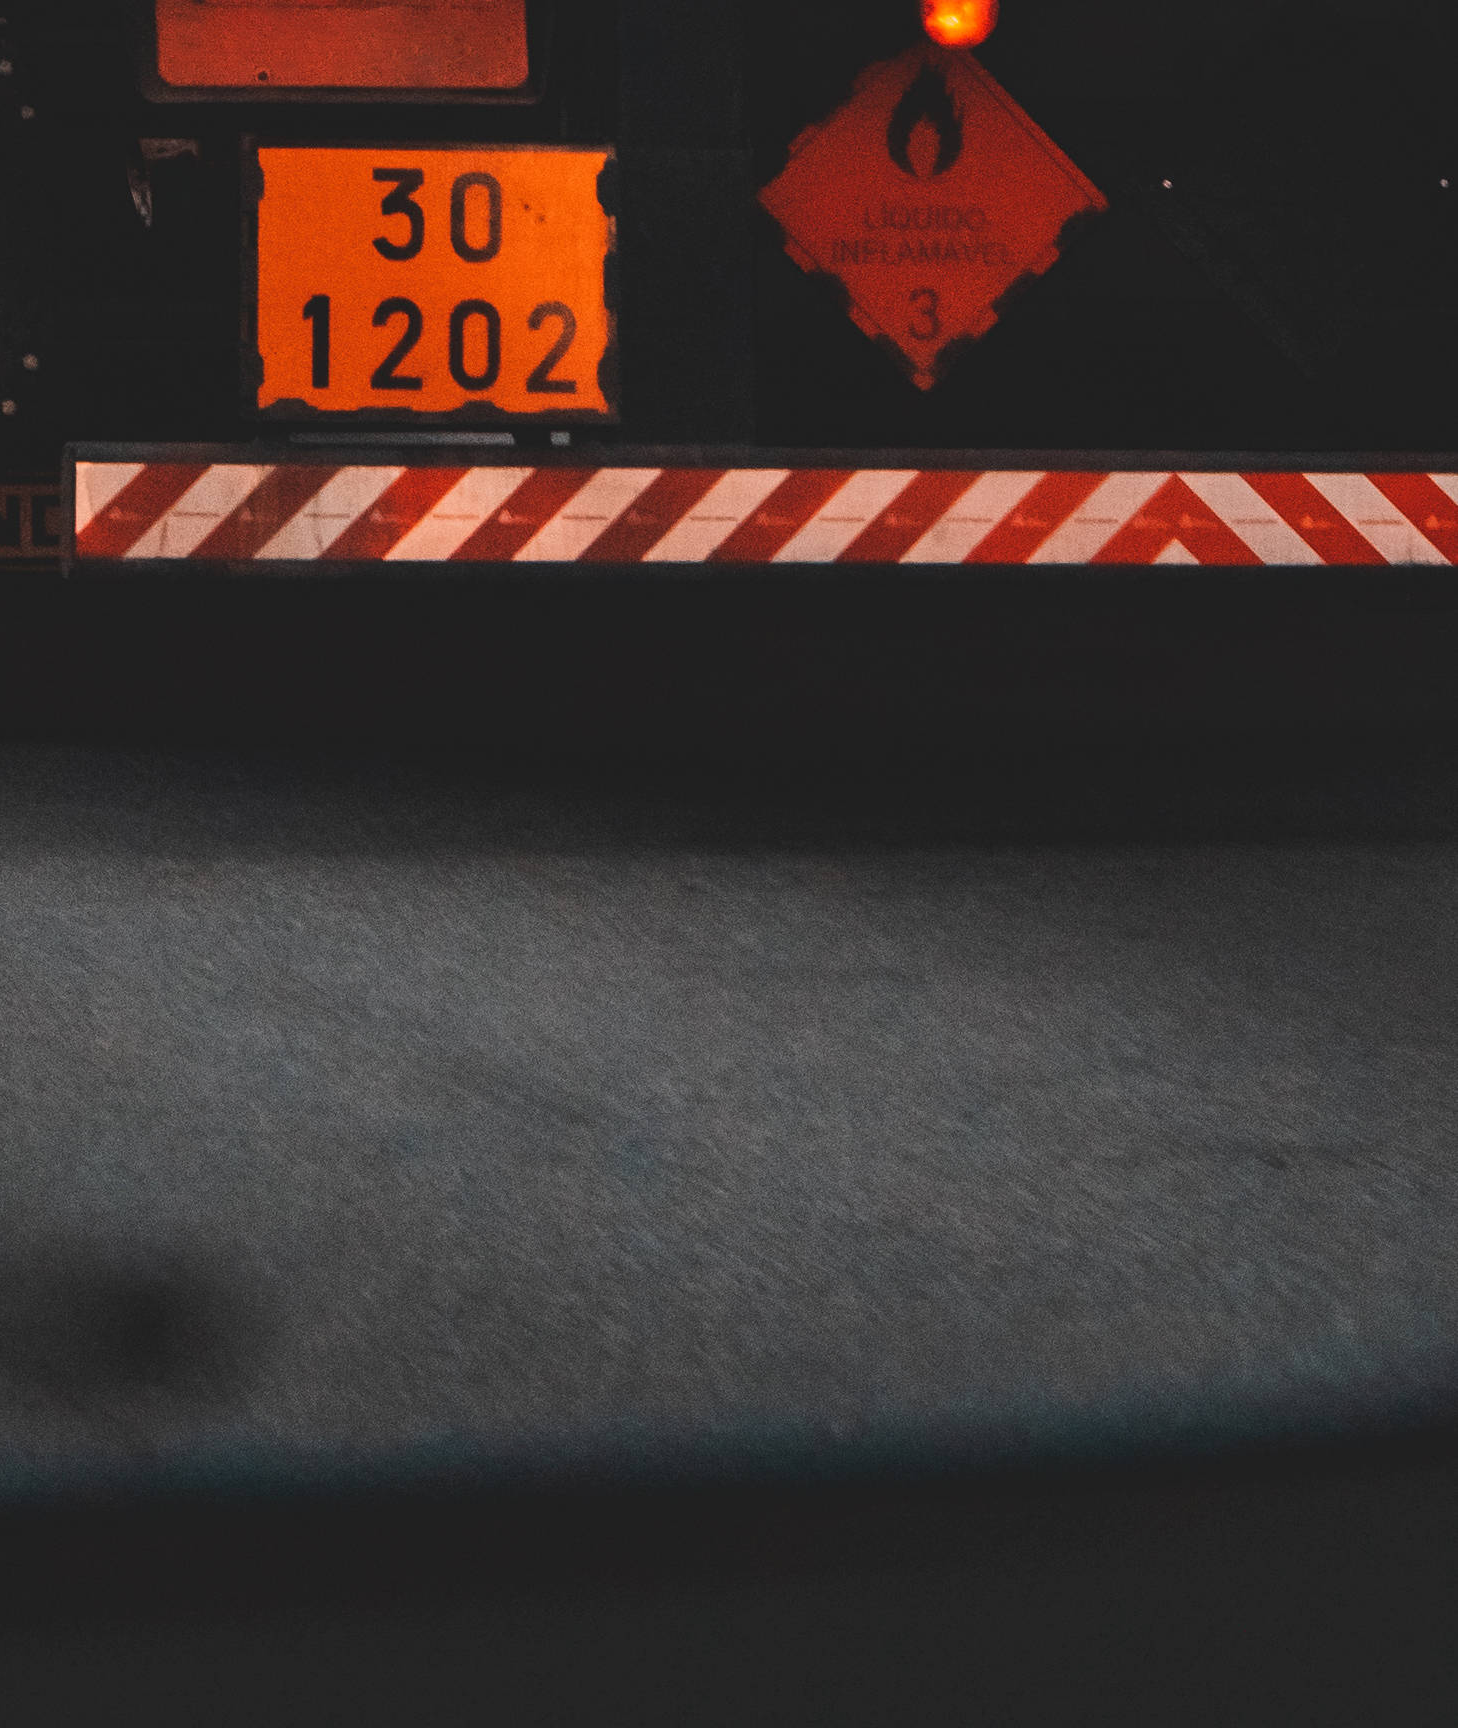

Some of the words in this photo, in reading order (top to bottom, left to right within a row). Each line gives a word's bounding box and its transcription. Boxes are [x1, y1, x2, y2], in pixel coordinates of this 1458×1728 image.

[371, 167, 502, 264] 30
[302, 293, 578, 395] 1202
[908, 286, 942, 341] 3
